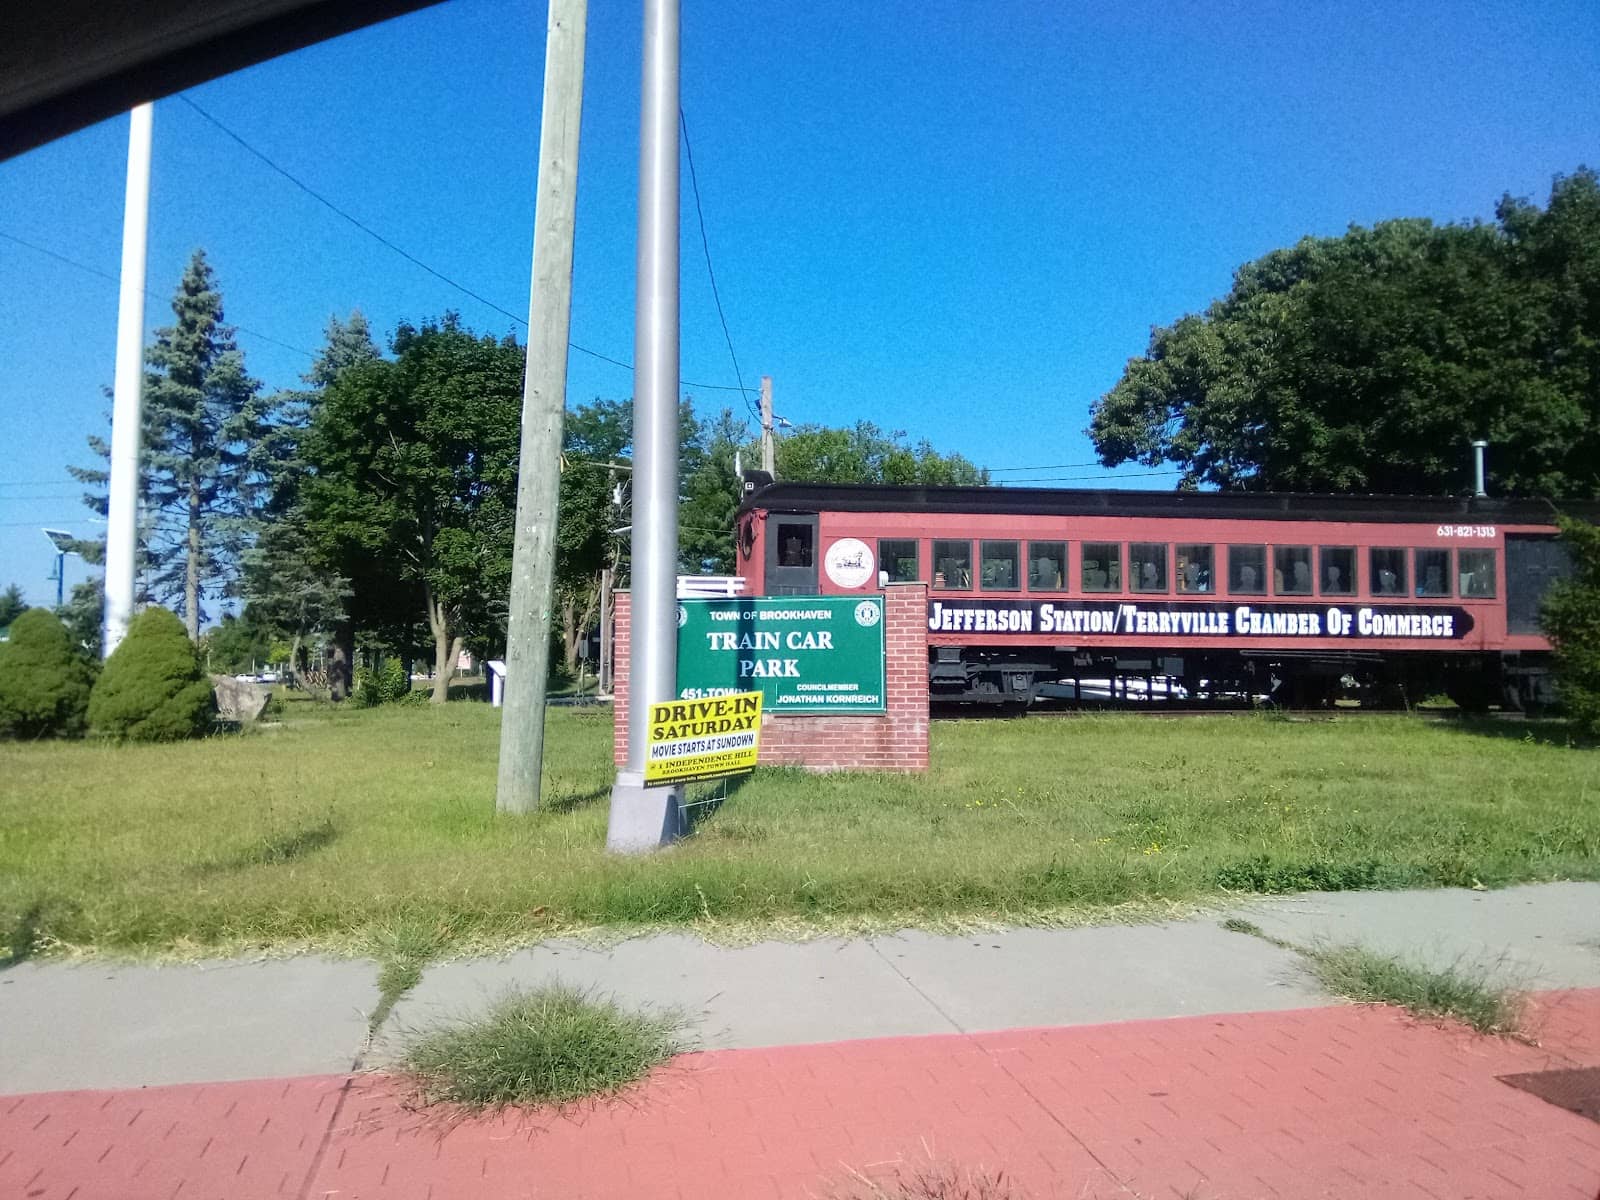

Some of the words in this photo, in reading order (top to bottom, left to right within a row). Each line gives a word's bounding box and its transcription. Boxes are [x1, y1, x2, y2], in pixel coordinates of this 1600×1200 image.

[709, 611, 740, 621] TOWN
[743, 611, 758, 620] OF
[759, 610, 832, 620] BROOKHAVEN
[929, 602, 1033, 632] JEFFERSON
[1039, 603, 1229, 634] STATION/TERRYVILLE
[1235, 606, 1321, 635] CHAMBER
[1327, 607, 1352, 635] OF
[1358, 608, 1454, 636] COMMERCE
[706, 632, 781, 650] TRAIN
[786, 631, 834, 650] CAR
[739, 659, 801, 678] PARK
[796, 683, 859, 691] COUNCILMEMBER
[777, 694, 825, 704] JONATHAN
[825, 694, 879, 704] KORNREICH
[653, 696, 759, 724] DRIVE-IN
[653, 715, 757, 741] SATURDAY
[651, 743, 678, 758] MOVIE
[678, 740, 706, 755] STARTS
[706, 740, 716, 751] AT
[716, 733, 754, 749] SUNDOWN
[665, 753, 732, 769] INDEPENDENCE
[734, 751, 753, 759] HILL
[662, 765, 705, 775] BROOKHAVEN
